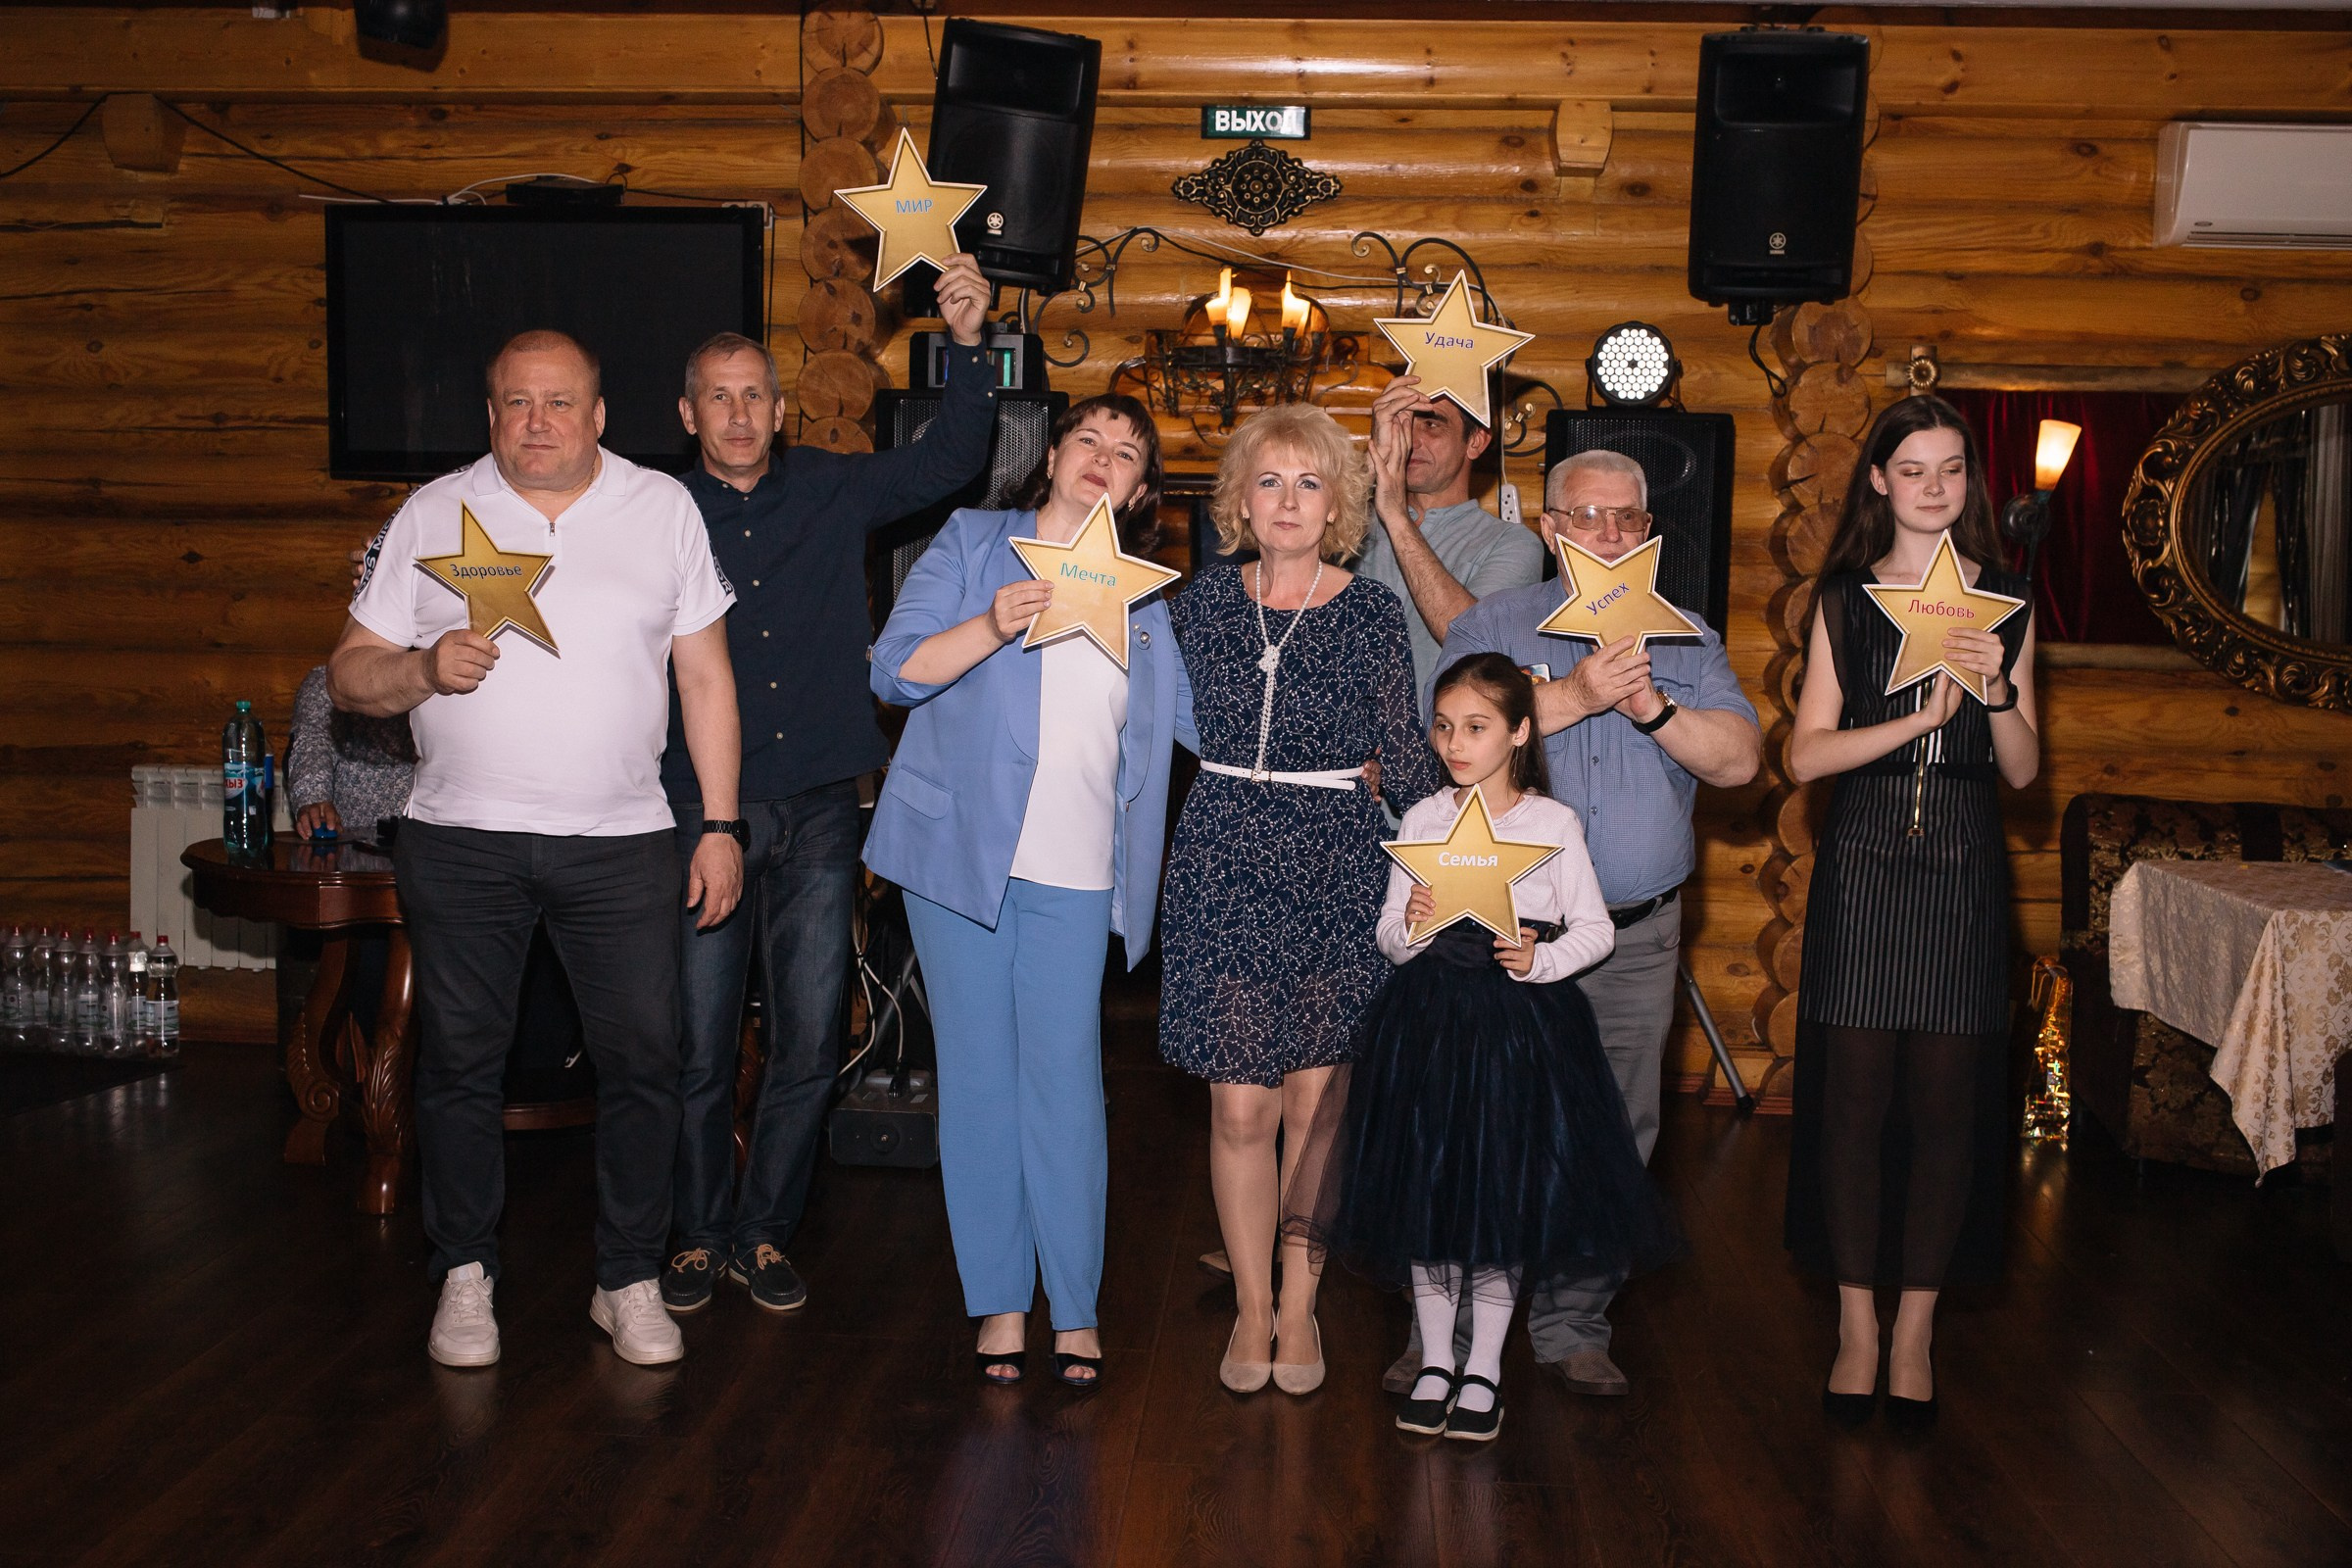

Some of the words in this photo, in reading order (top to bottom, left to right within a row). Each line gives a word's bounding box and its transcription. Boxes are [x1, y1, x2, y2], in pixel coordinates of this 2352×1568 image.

[1215, 110, 1300, 133] ВЫХОД
[896, 198, 933, 214] МИР
[1425, 331, 1474, 349] Удача
[450, 564, 522, 579] Здоровье
[1060, 563, 1116, 587] Мечта
[1586, 582, 1630, 615] Успех
[1908, 599, 1975, 618] Любовь
[1438, 852, 1498, 867] Семья
